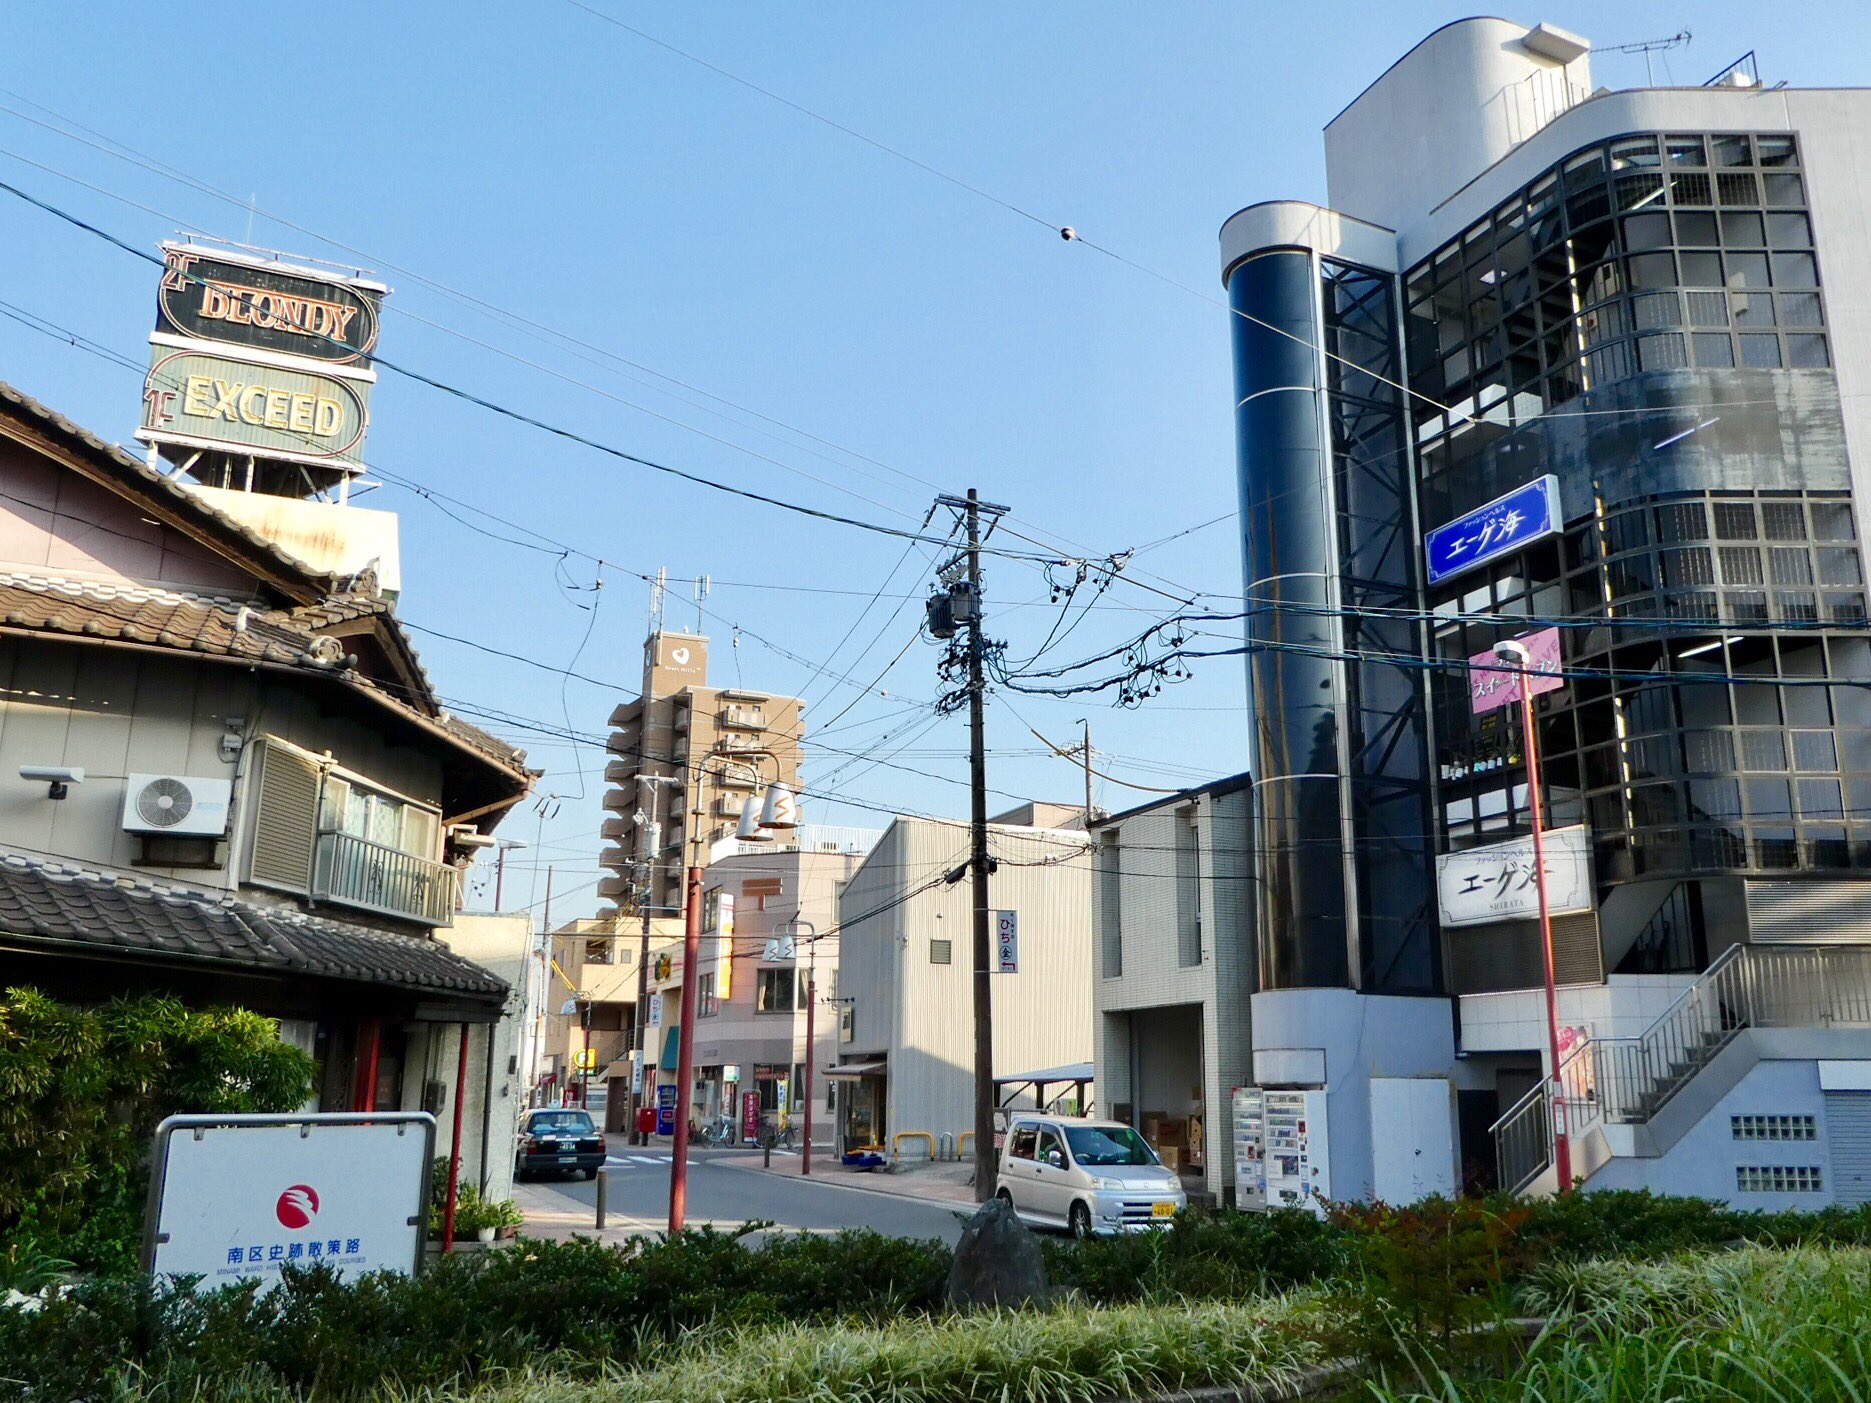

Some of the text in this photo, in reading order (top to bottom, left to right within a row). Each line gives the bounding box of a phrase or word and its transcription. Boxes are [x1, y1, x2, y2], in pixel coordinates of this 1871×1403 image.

[160, 252, 199, 292] 2F
[198, 278, 357, 342] BLONDY
[184, 375, 344, 437] EXCEED
[1445, 509, 1527, 560] エーゲ海
[1489, 899, 1524, 911] SHIBATA
[227, 1238, 360, 1265] 南区史跡散策路
